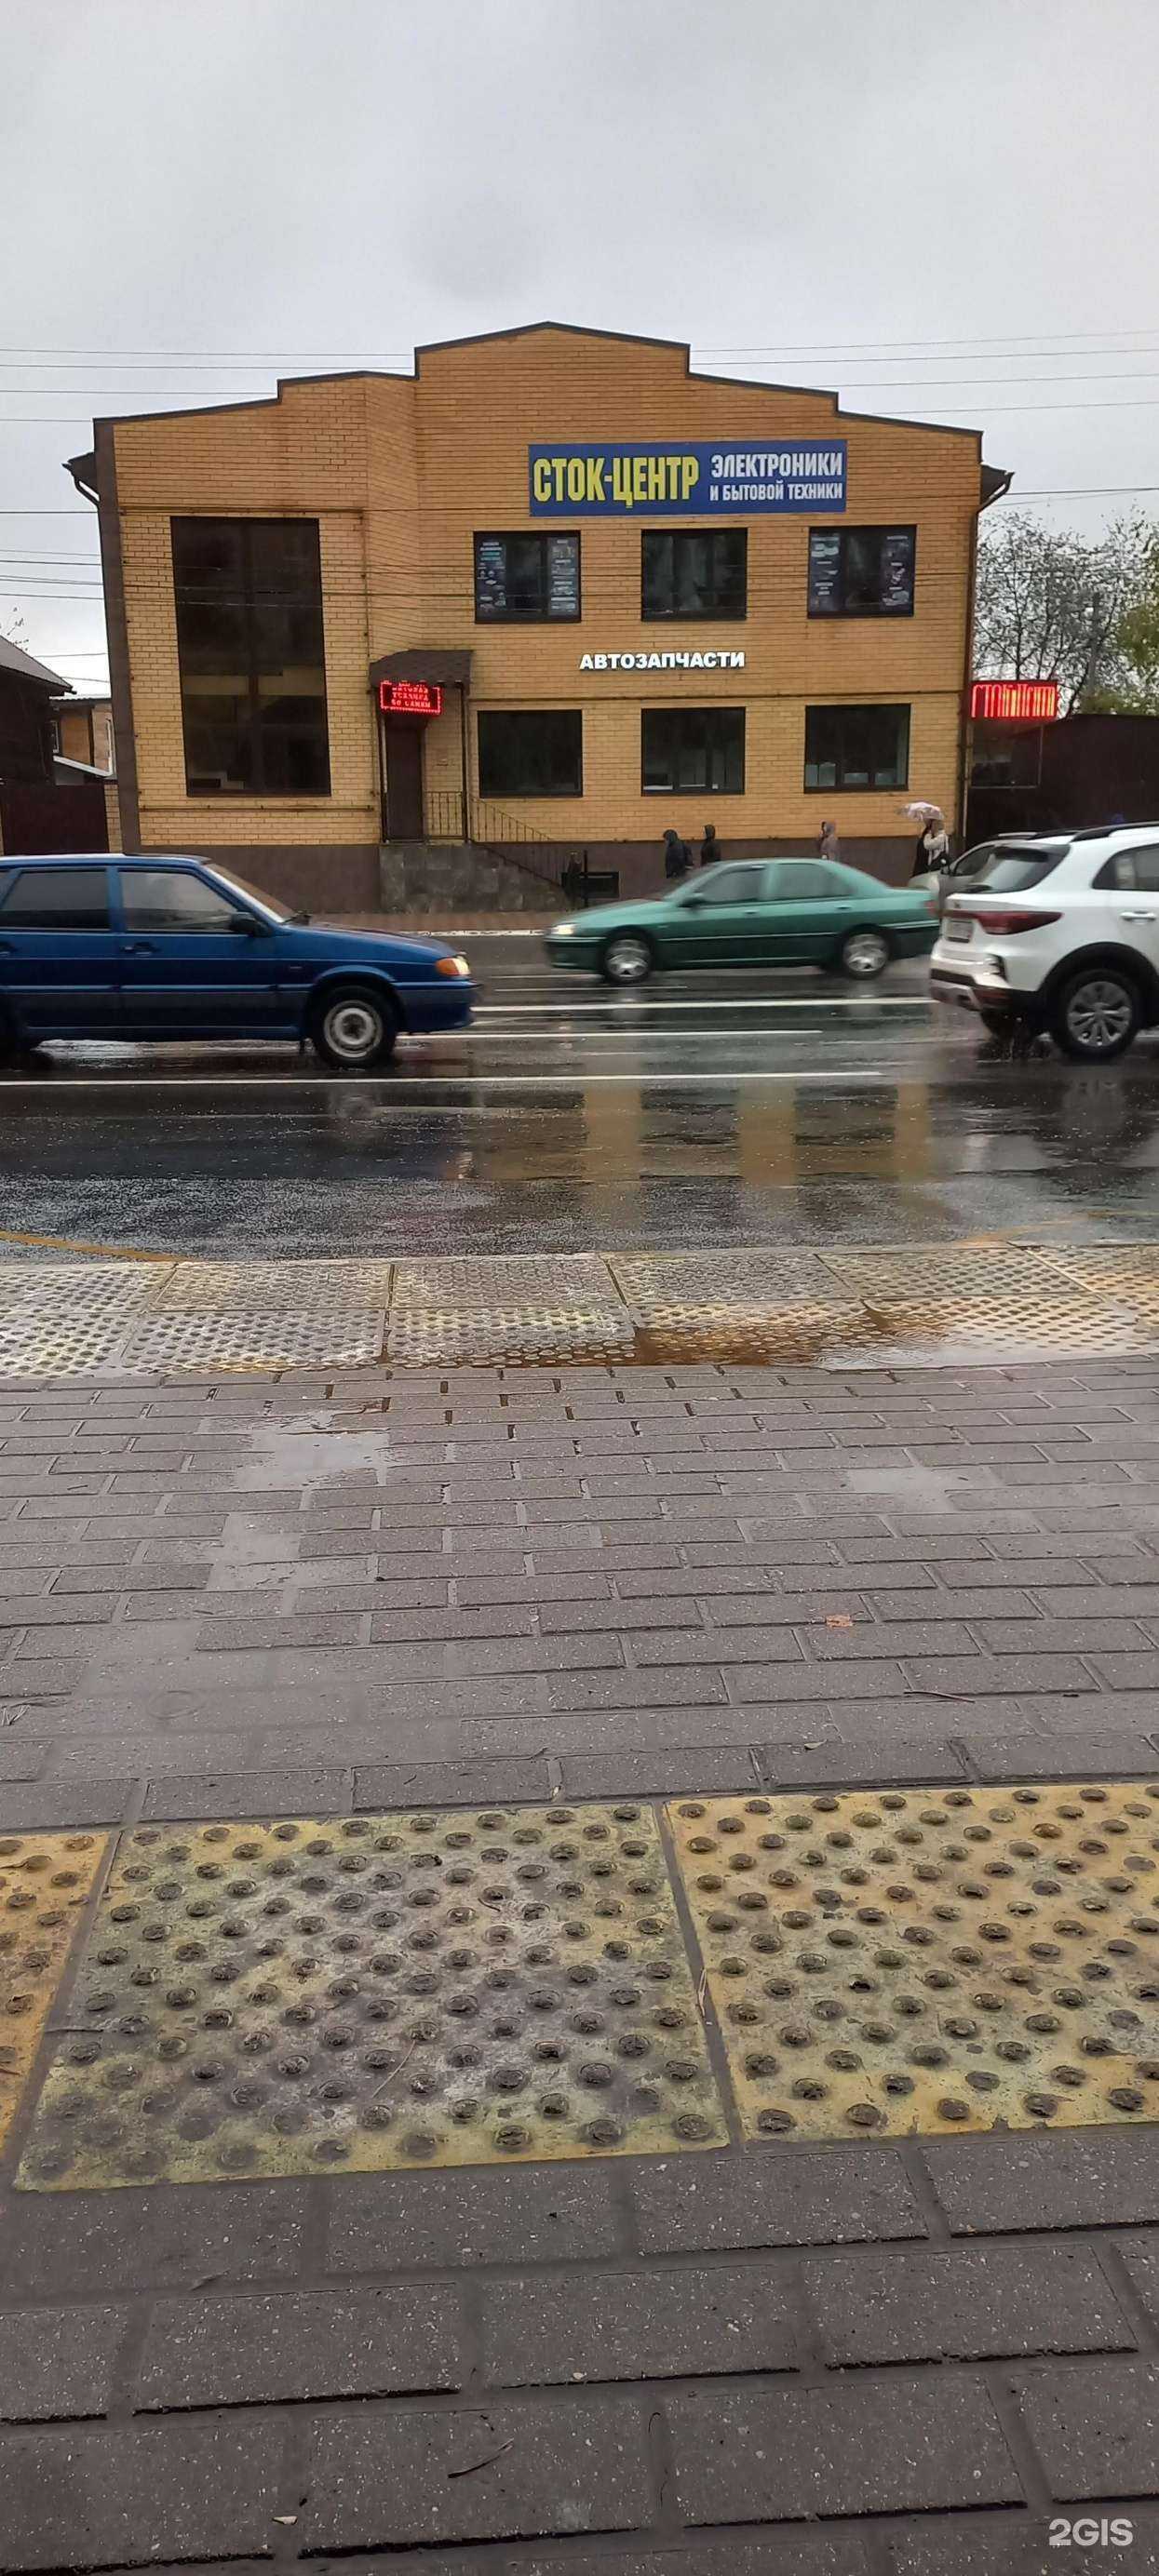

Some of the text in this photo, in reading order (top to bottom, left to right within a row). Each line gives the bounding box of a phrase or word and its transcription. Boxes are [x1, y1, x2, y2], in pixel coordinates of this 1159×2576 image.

[710, 452, 842, 478] ЭЛЕКТРОНИКИ
[532, 456, 700, 508] СТОК-ЦЕНТР
[709, 479, 842, 502] И БЫТОВОЙ ТЕХНИКИ
[579, 651, 746, 670] АВТОЗАПЧАСТИ
